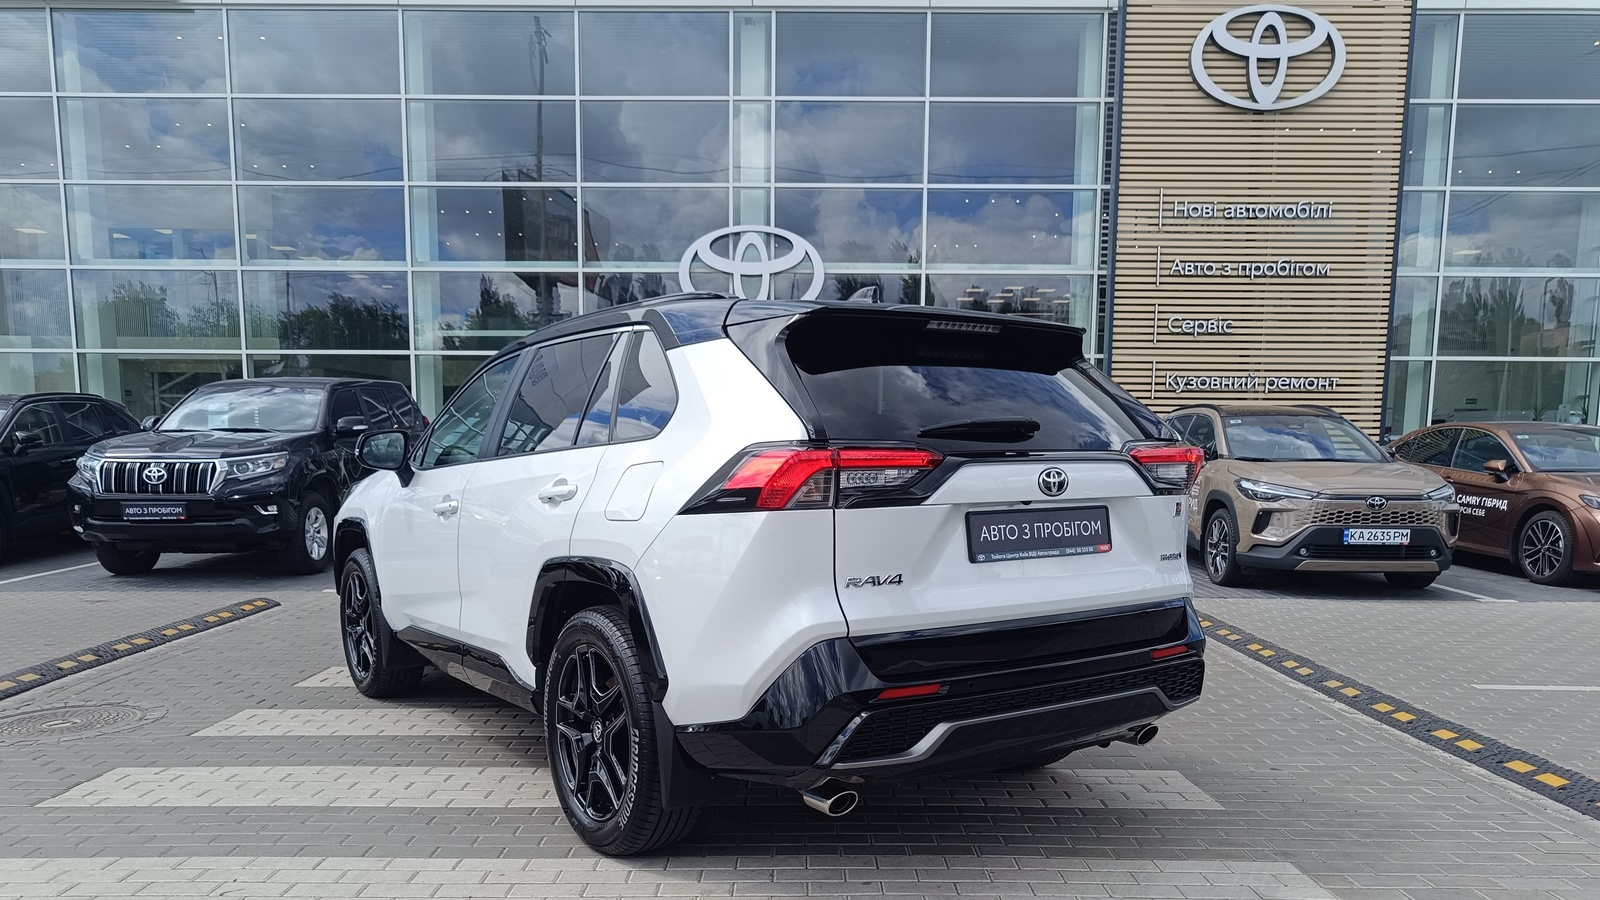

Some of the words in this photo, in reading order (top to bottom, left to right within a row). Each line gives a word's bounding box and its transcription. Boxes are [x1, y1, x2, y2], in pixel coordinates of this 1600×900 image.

[1173, 200, 1218, 219] Нові
[1223, 200, 1334, 219] автомобілі
[1169, 258, 1217, 277] Авто
[1221, 263, 1232, 276] з
[1238, 258, 1331, 280] пробігом
[1167, 316, 1234, 337] Сервіс
[1165, 372, 1259, 393] Кузовний
[1264, 377, 1340, 394] ремонт
[1456, 494, 1481, 506] CAMRY
[1481, 497, 1508, 511] ГІБРИД
[1472, 508, 1486, 517] СЕБЕ
[980, 524, 1019, 542] АВТО
[1034, 520, 1102, 539] ПРОБІГОМ
[1350, 531, 1365, 541] KA
[1367, 531, 1391, 541] 2635
[1393, 531, 1409, 541] PM
[844, 573, 904, 589] RAV4
[618, 728, 640, 831] BRIDGESTONE
